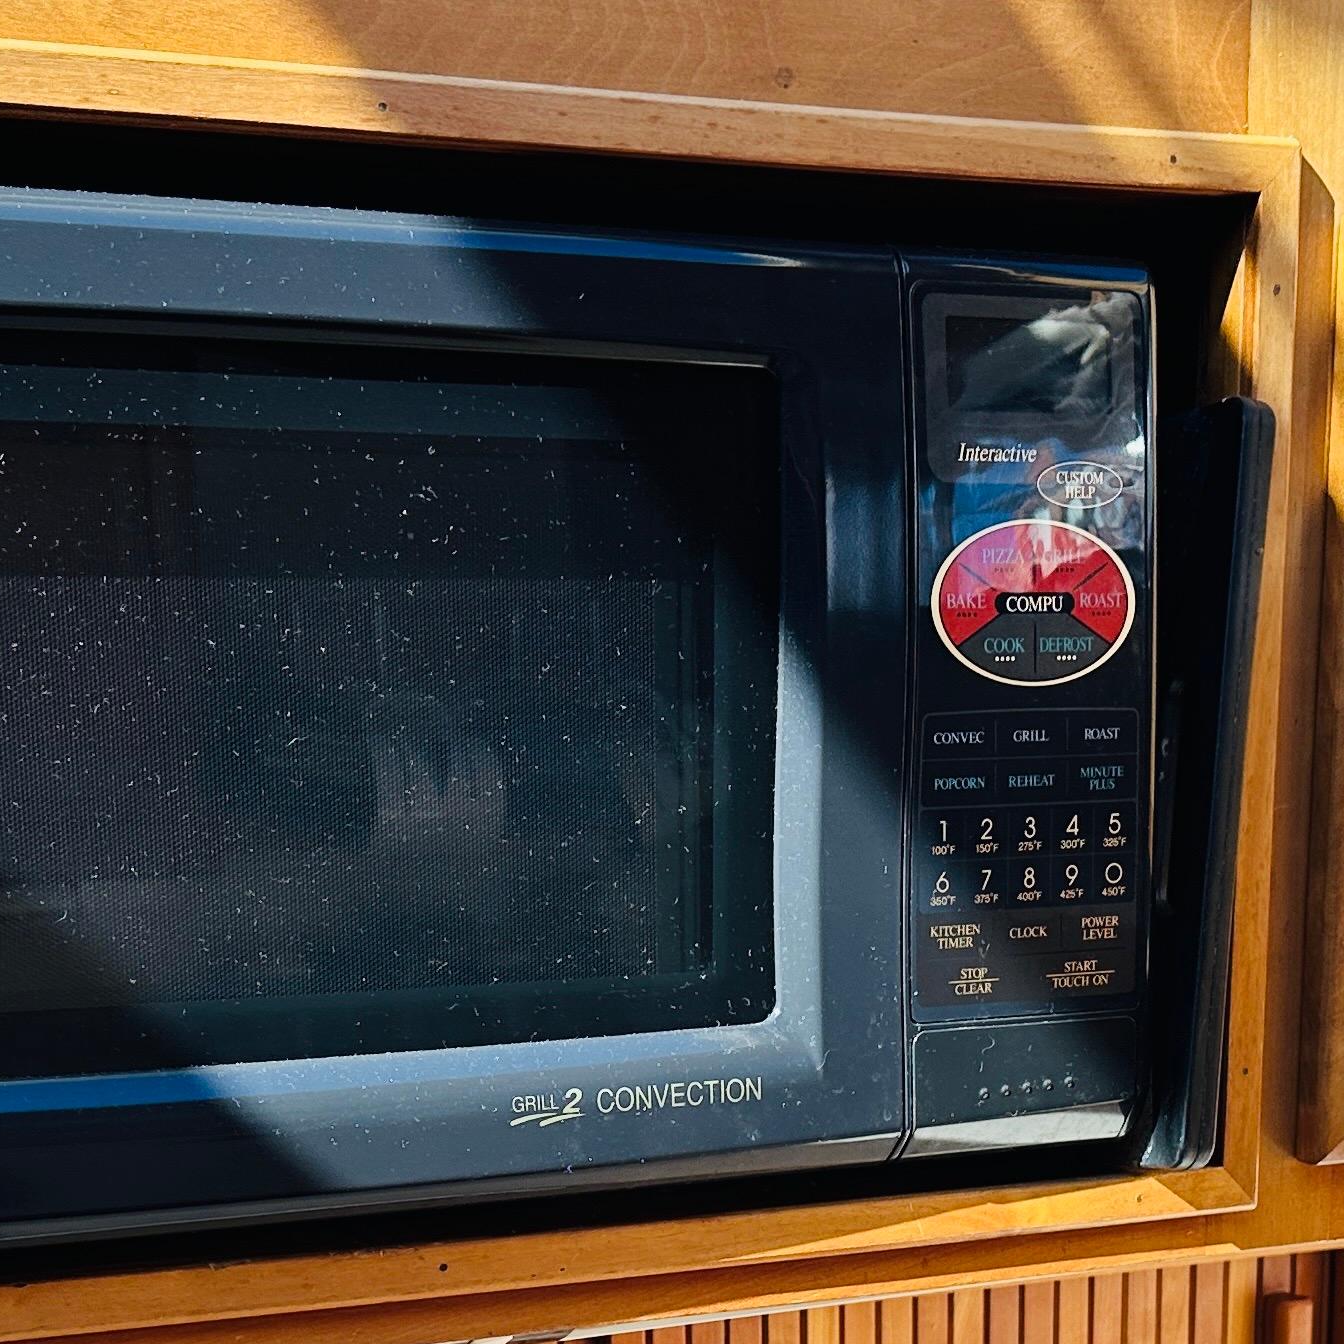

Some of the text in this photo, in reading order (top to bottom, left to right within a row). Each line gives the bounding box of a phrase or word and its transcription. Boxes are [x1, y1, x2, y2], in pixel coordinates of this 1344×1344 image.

[958, 442, 1037, 463] Interactive
[1056, 470, 1104, 486] CUSTOM
[1065, 484, 1096, 499] HELP
[981, 547, 1026, 564] PIZZA
[946, 592, 987, 609] BAKE
[1005, 595, 1064, 613] COMPU
[1079, 591, 1124, 609] ROAST
[983, 636, 1025, 654] COOK
[1039, 635, 1095, 653] DEFROST
[934, 731, 984, 744] CONVEC
[1013, 730, 1049, 742] GRILL
[1084, 728, 1121, 740] ROAST
[1080, 766, 1124, 778] MINUTE
[934, 776, 986, 790] POPCORN
[1008, 774, 1055, 788] REHEAT
[1089, 778, 1116, 791] PLUS
[939, 820, 947, 841] 1
[980, 818, 993, 840] 2
[1024, 816, 1036, 838] 3
[1066, 815, 1079, 835] 4
[1108, 813, 1121, 834] 5
[936, 871, 949, 893] 6
[981, 869, 992, 890] 7
[1023, 867, 1035, 888] 8
[1065, 864, 1078, 886] 9
[1081, 915, 1119, 928] POWER
[930, 924, 980, 937] KITCHEN
[1009, 926, 1048, 939] CLOCK
[1083, 928, 1117, 940] LEVEL
[937, 937, 974, 949] TIMER
[960, 967, 988, 979] STOP
[1064, 960, 1098, 972] START
[955, 983, 992, 995] CLEAR
[1052, 974, 1109, 989] TOUCH ON
[512, 1077, 762, 1114] GRILL 2 CONVECTION
